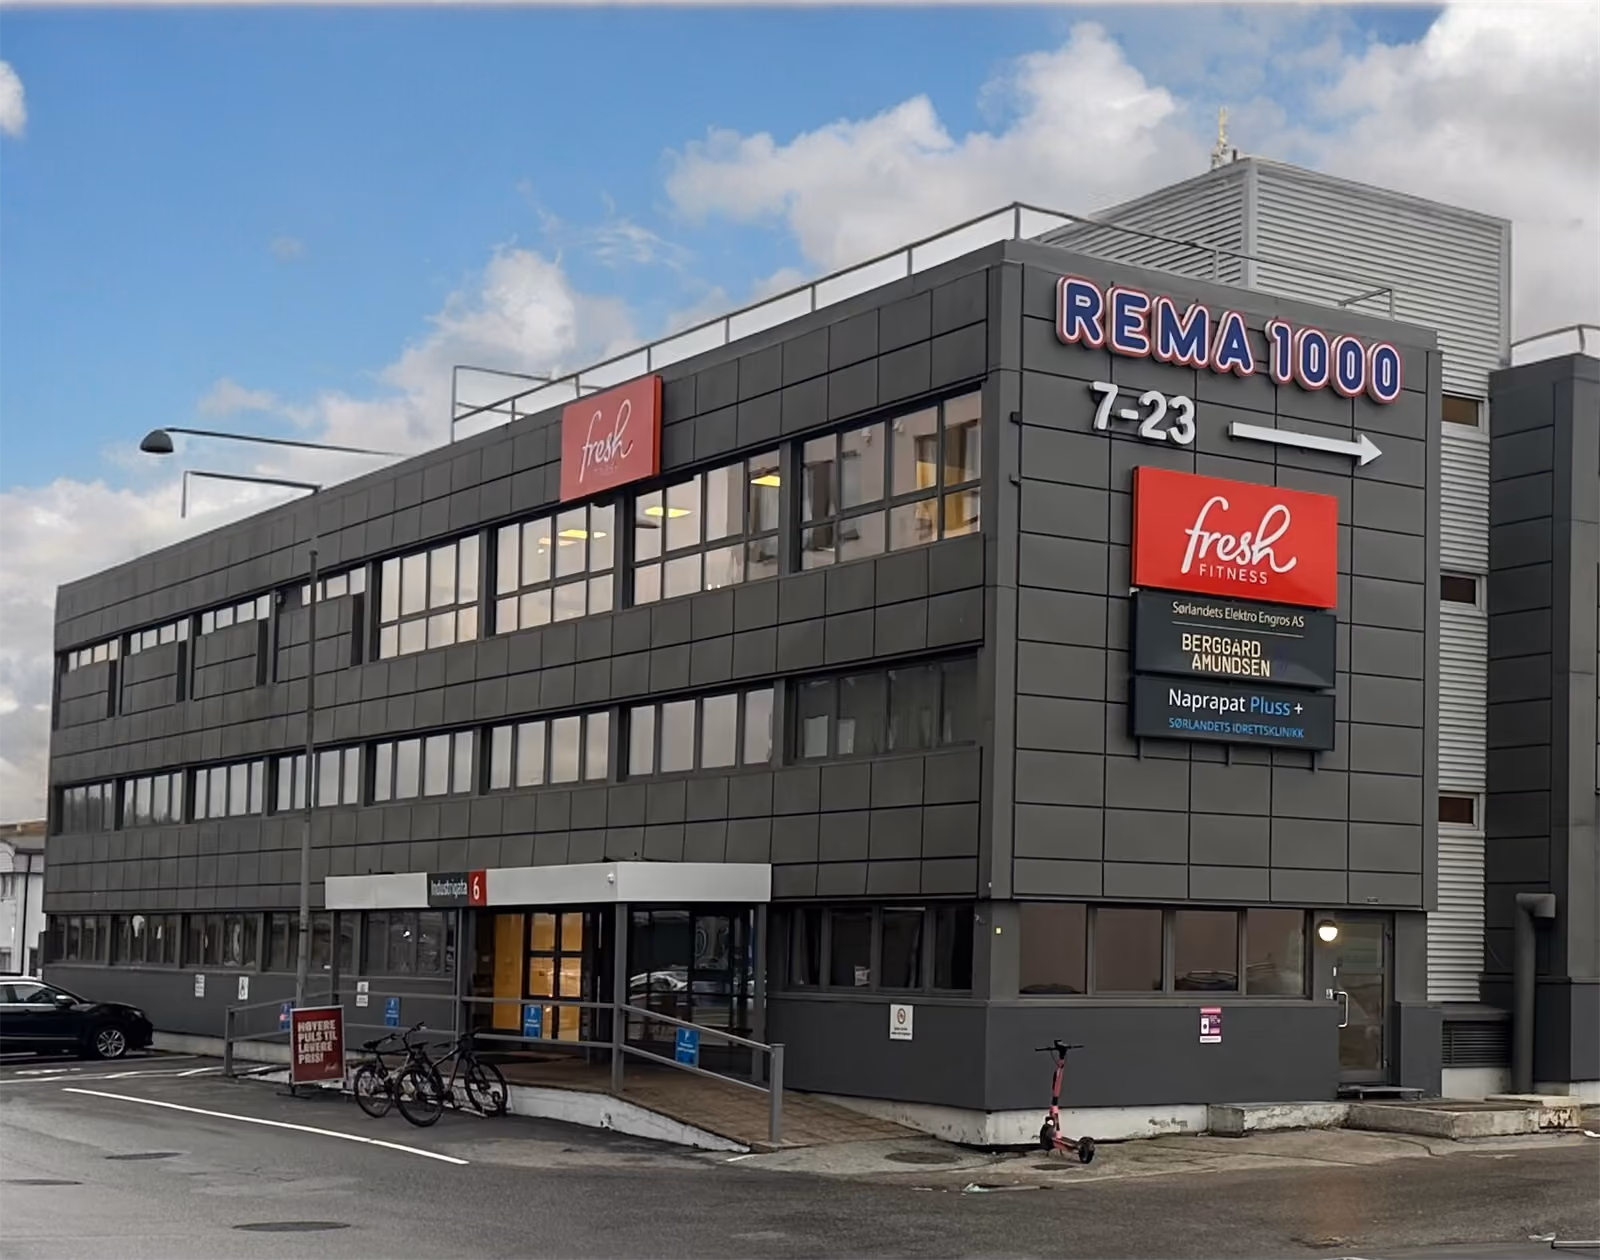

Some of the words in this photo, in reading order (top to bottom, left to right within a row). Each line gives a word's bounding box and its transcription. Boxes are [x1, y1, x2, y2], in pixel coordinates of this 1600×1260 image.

[1056, 275, 1256, 377] REMA
[1265, 319, 1402, 404] 1000
[1089, 381, 1196, 446] 7-23
[579, 399, 634, 484] fresh
[1181, 496, 1297, 574] fresh
[1199, 563, 1268, 585] FITNESS
[1172, 601, 1224, 619] Sørlandets
[1225, 607, 1257, 623] Elektro
[1259, 611, 1290, 627] Engros
[1291, 616, 1305, 628] AS
[1182, 633, 1261, 658] BERGGÅRD
[1191, 653, 1270, 677] AMUNDSEN
[1169, 688, 1246, 715] Naprapat
[1250, 696, 1291, 716] Pluss
[1168, 717, 1230, 733] SØRLANDETS
[1232, 723, 1305, 738] IDRETTSKLINIKK
[473, 876, 480, 900] 6
[298, 1031, 323, 1043] PULS
[323, 1030, 337, 1041] TIL
